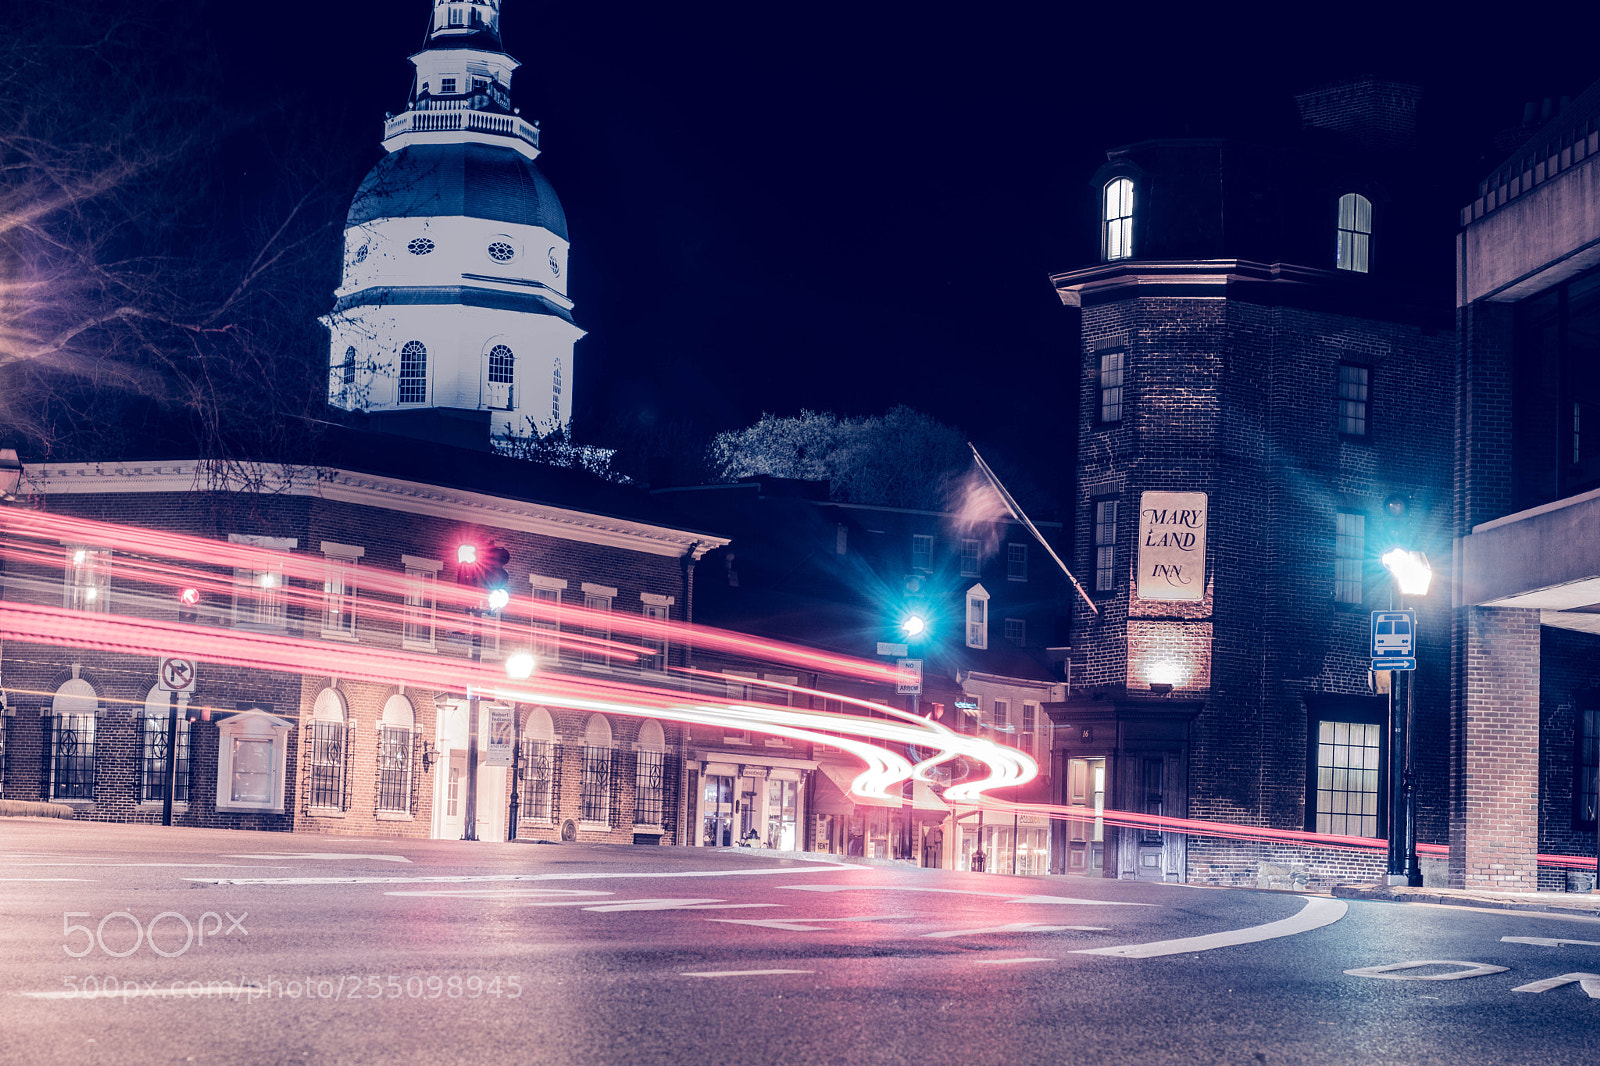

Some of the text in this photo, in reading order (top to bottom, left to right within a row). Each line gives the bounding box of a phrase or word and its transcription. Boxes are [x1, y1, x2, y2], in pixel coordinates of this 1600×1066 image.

[1142, 509, 1204, 528] MARY
[1145, 531, 1196, 551] LAND
[1152, 564, 1191, 587] INN
[899, 685, 919, 693] ARROW
[1082, 729, 1089, 738] 16
[817, 842, 829, 850] RENT
